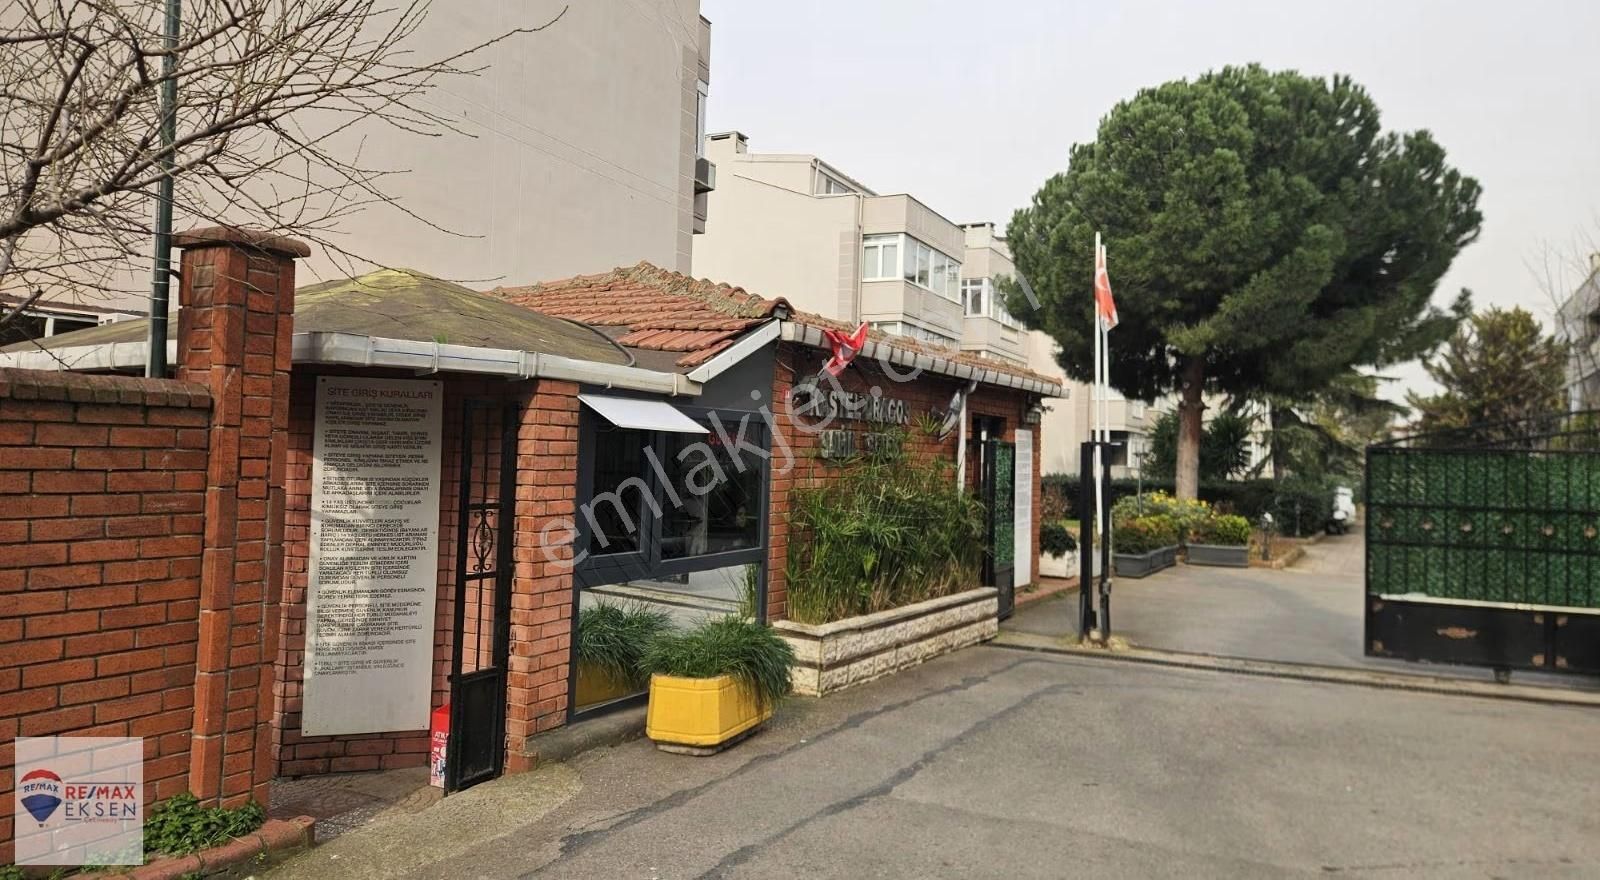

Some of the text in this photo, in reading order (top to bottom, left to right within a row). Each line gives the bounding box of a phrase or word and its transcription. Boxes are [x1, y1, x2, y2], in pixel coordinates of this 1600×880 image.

[328, 386, 432, 399] SİTE GİRİŞ KURALLARI
